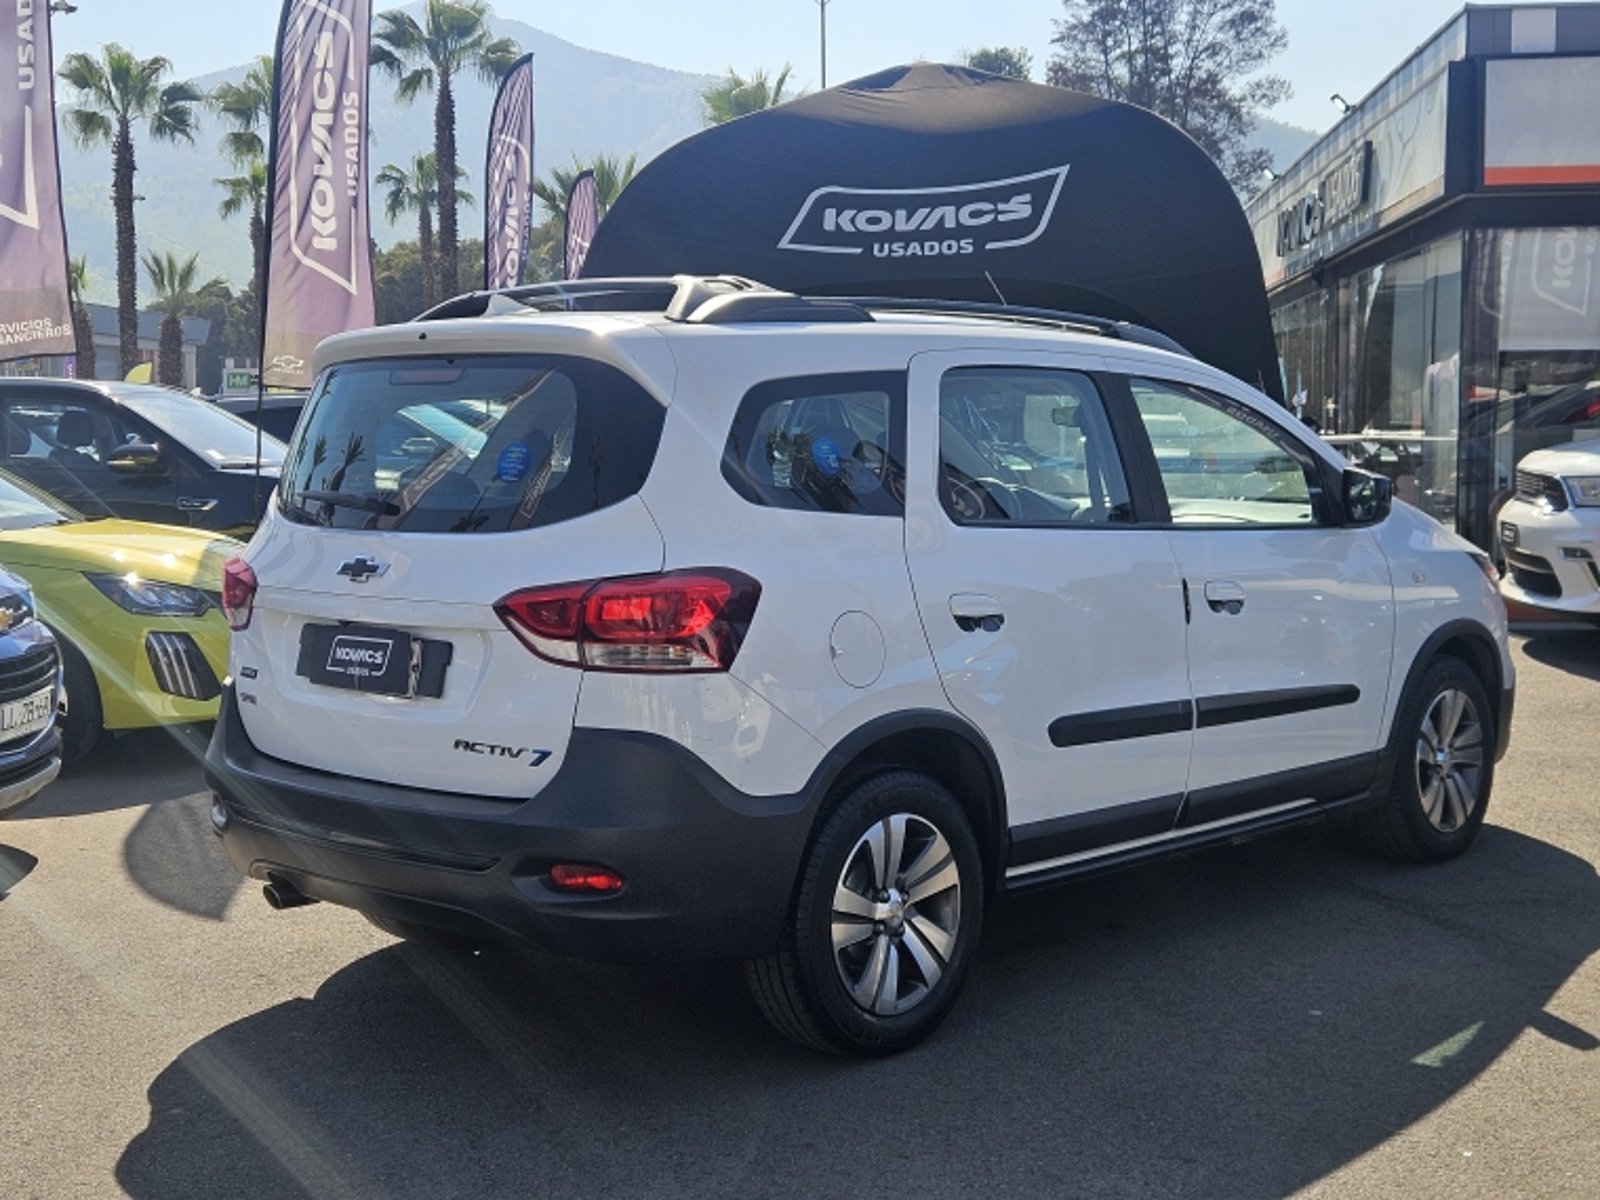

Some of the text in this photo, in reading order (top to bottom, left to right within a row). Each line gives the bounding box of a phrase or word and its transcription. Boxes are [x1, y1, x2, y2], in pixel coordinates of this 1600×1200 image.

[311, 31, 338, 250] KOVACS
[343, 91, 359, 196] USADOS
[823, 193, 1032, 231] KOVACS
[873, 238, 974, 257] USADOS
